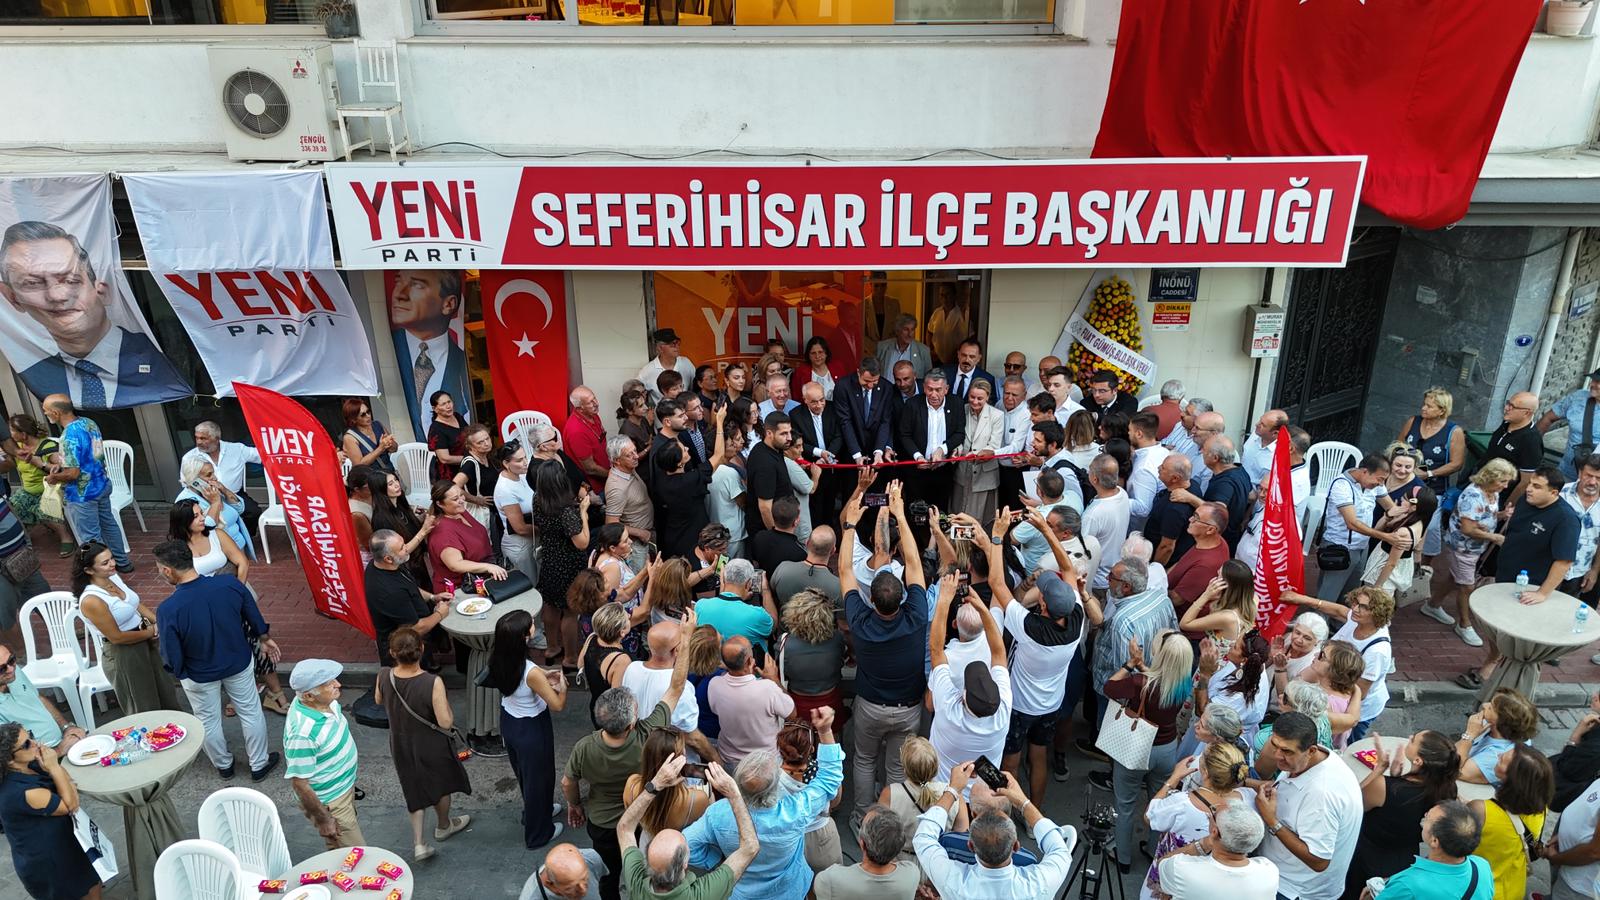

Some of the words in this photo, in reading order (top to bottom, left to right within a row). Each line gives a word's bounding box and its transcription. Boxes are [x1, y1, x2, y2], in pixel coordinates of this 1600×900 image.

[531, 179, 866, 248] SEFERİHİSAR
[879, 178, 993, 260] İLÇE
[1002, 176, 1335, 260] BAŞKANLIĞI
